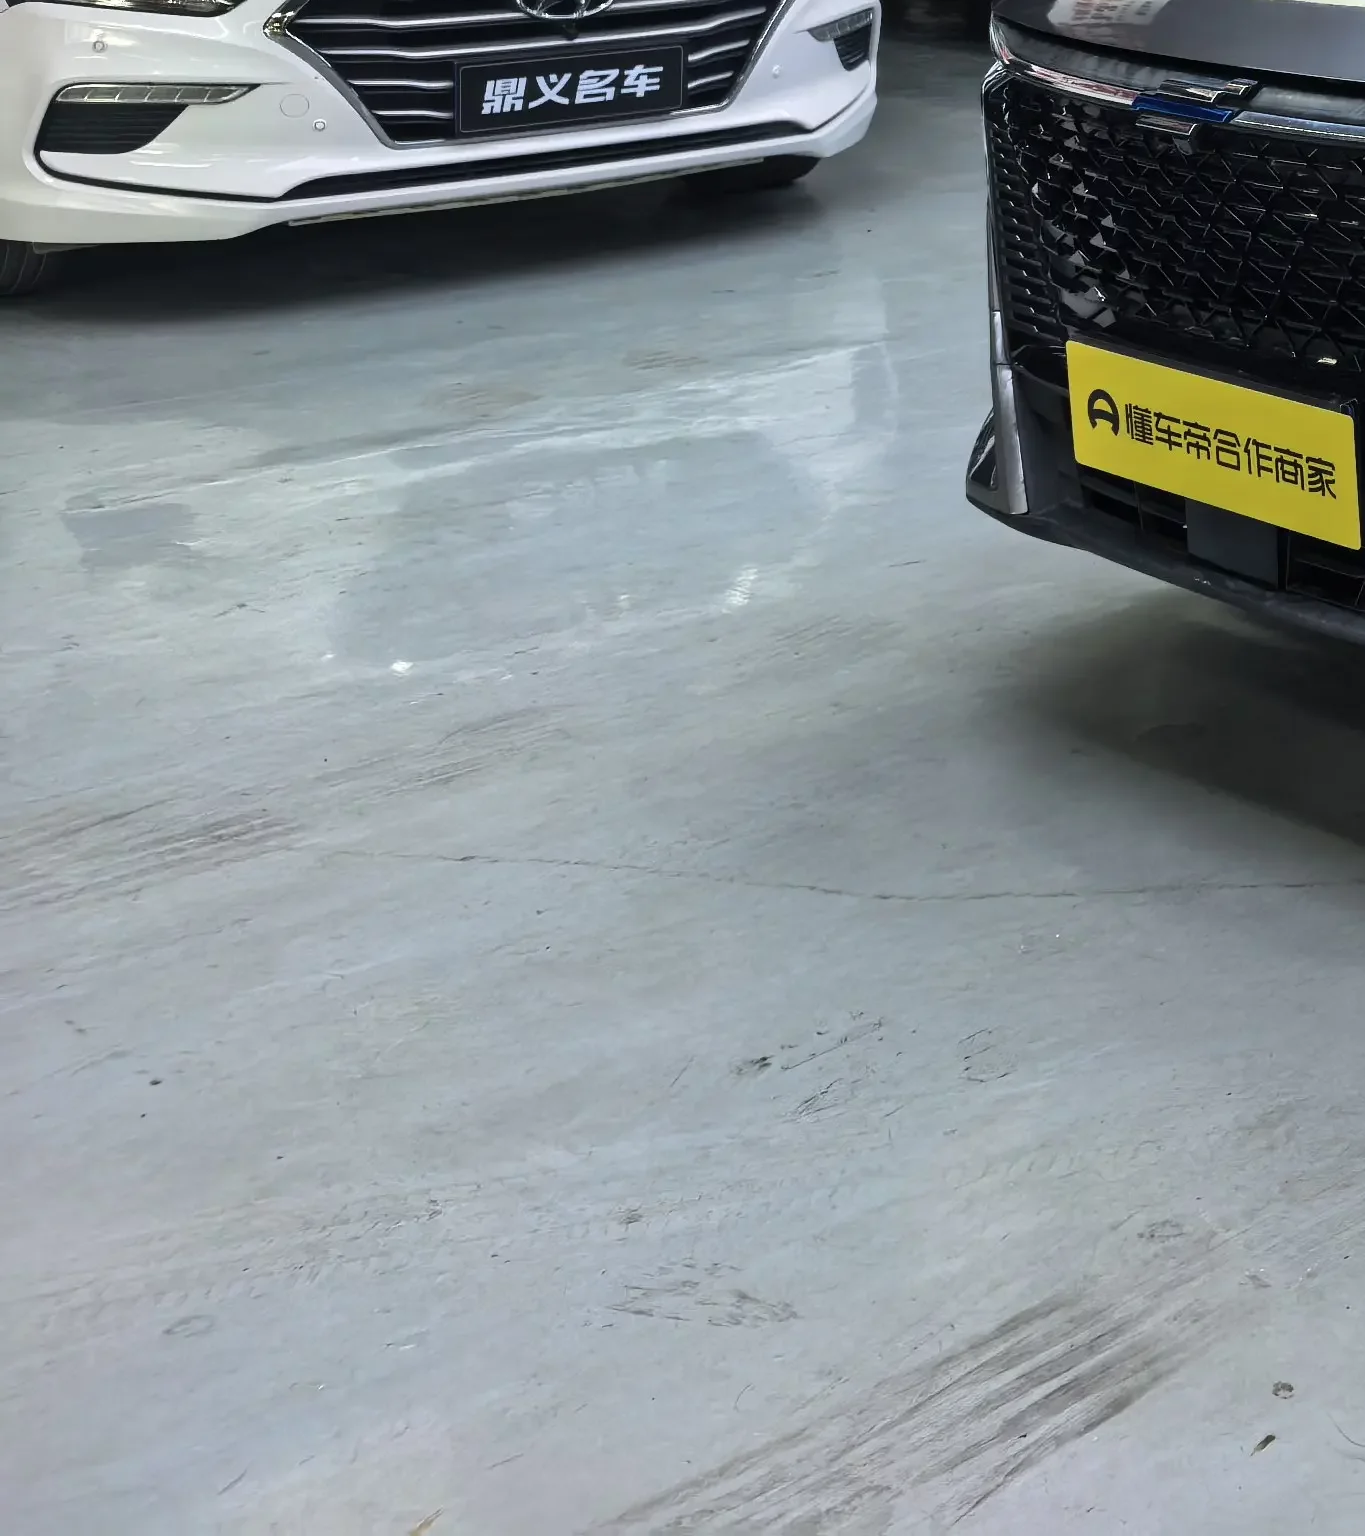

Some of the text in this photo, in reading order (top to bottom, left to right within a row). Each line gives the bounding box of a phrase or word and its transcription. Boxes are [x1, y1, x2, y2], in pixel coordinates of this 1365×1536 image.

[480, 64, 664, 114] 鼎义名车
[1125, 402, 1337, 500] 懂车帝合作商家
